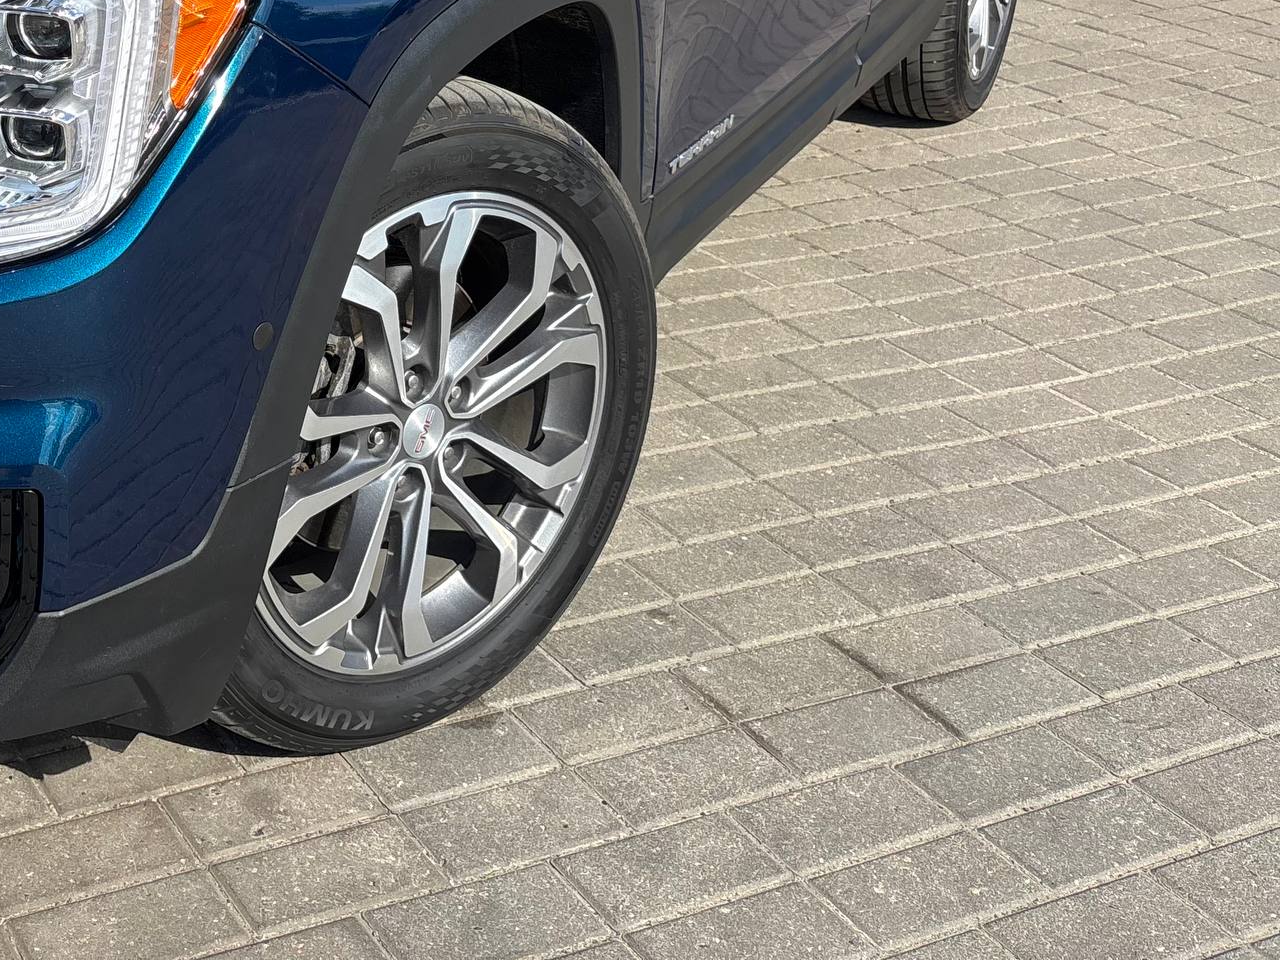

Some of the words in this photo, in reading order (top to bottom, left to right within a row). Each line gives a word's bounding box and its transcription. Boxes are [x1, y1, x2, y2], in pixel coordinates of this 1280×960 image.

[669, 114, 736, 174] TERRAIN
[415, 407, 435, 453] GMC
[261, 679, 374, 731] KUMHO
